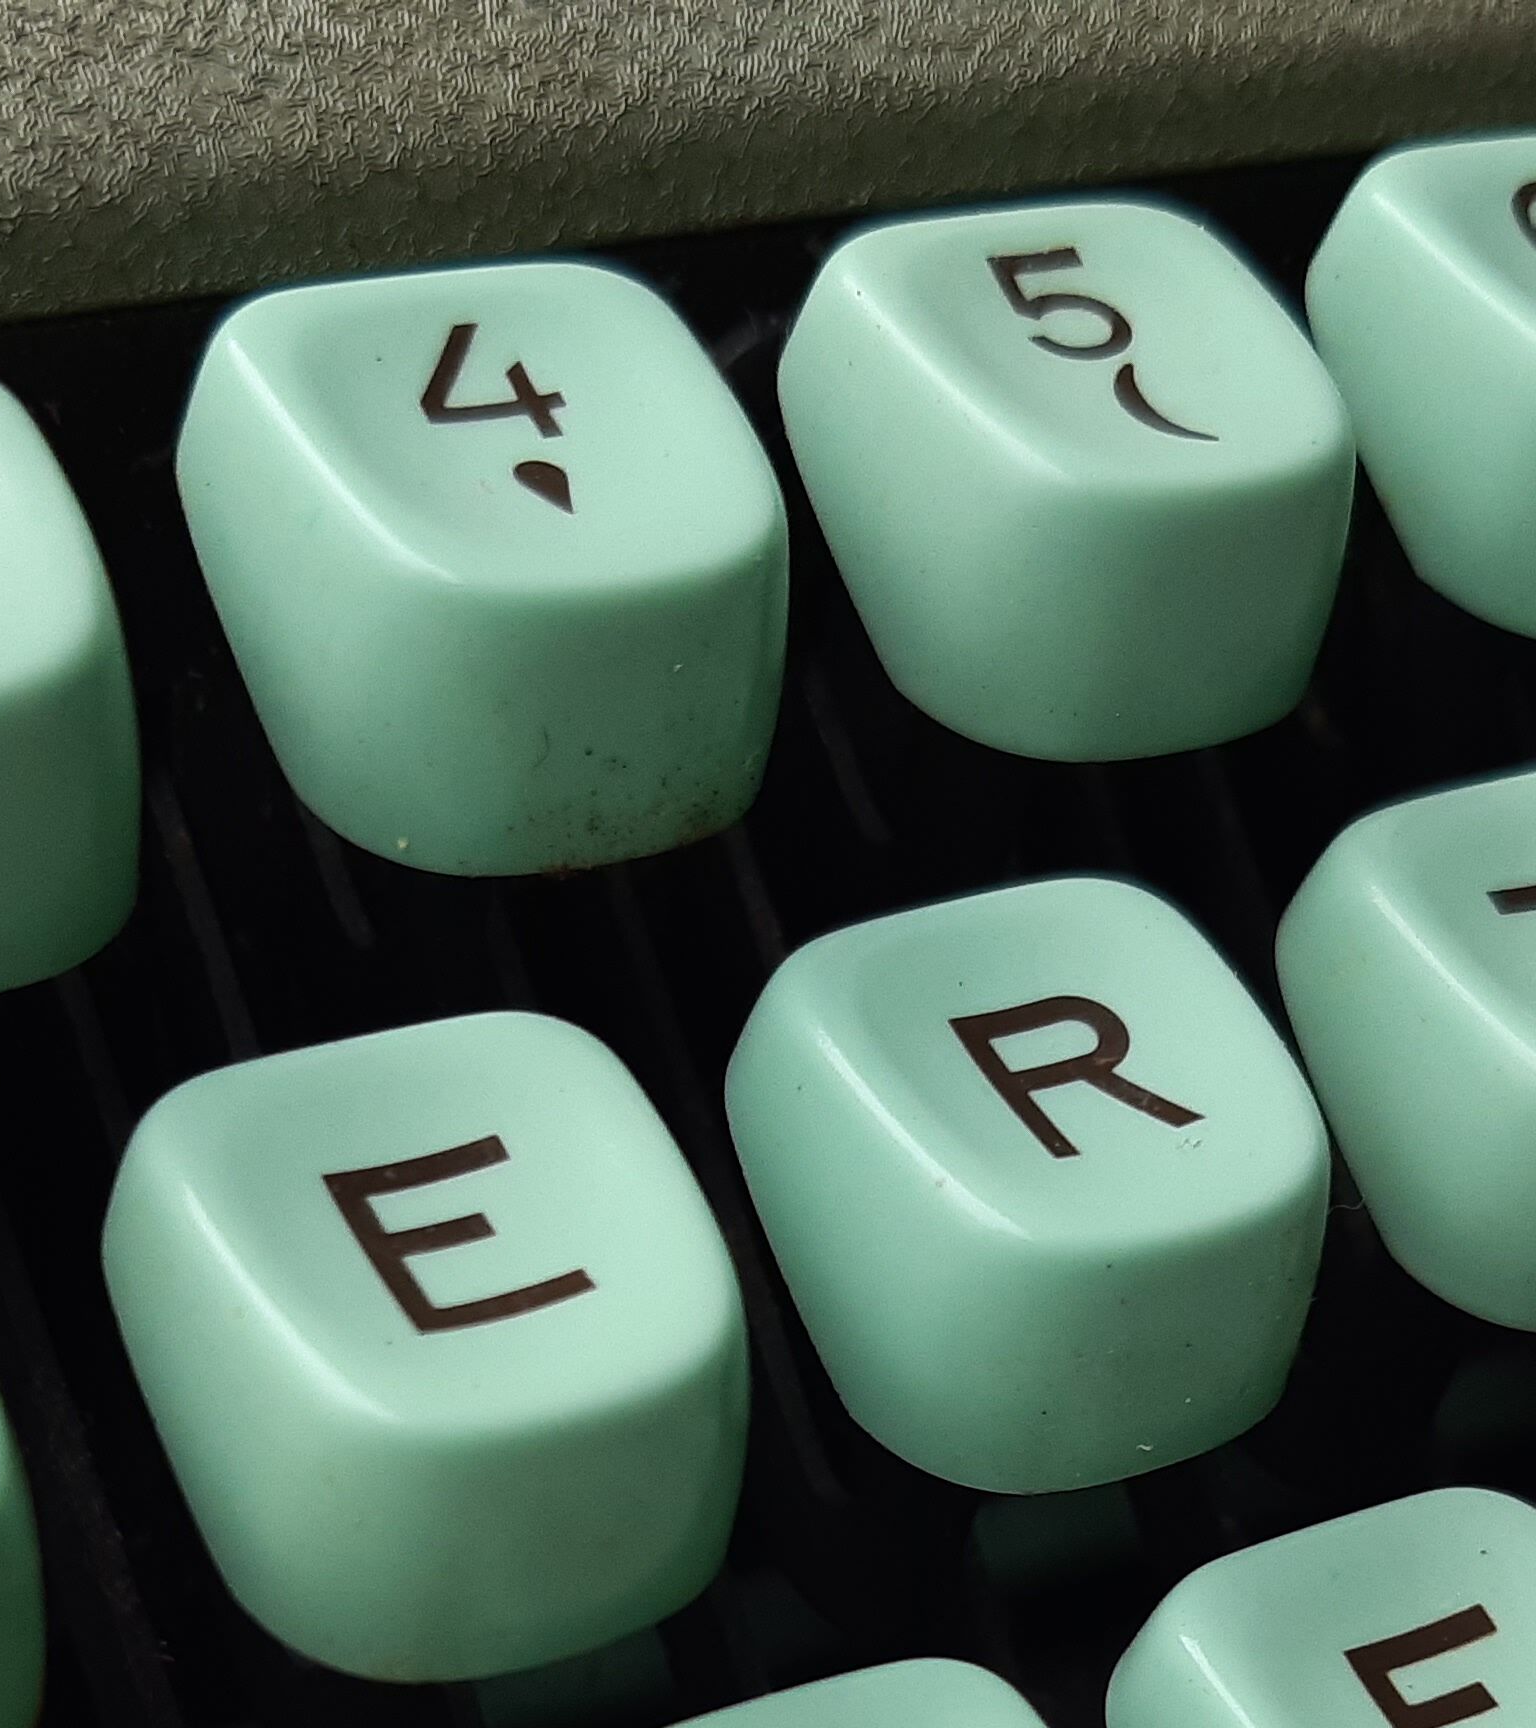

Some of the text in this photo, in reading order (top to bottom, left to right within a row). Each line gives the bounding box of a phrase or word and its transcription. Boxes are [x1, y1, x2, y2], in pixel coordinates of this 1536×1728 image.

[987, 247, 1132, 358] 5
[420, 323, 564, 437] 4
[948, 996, 1203, 1158] R
[321, 1135, 594, 1334] E
